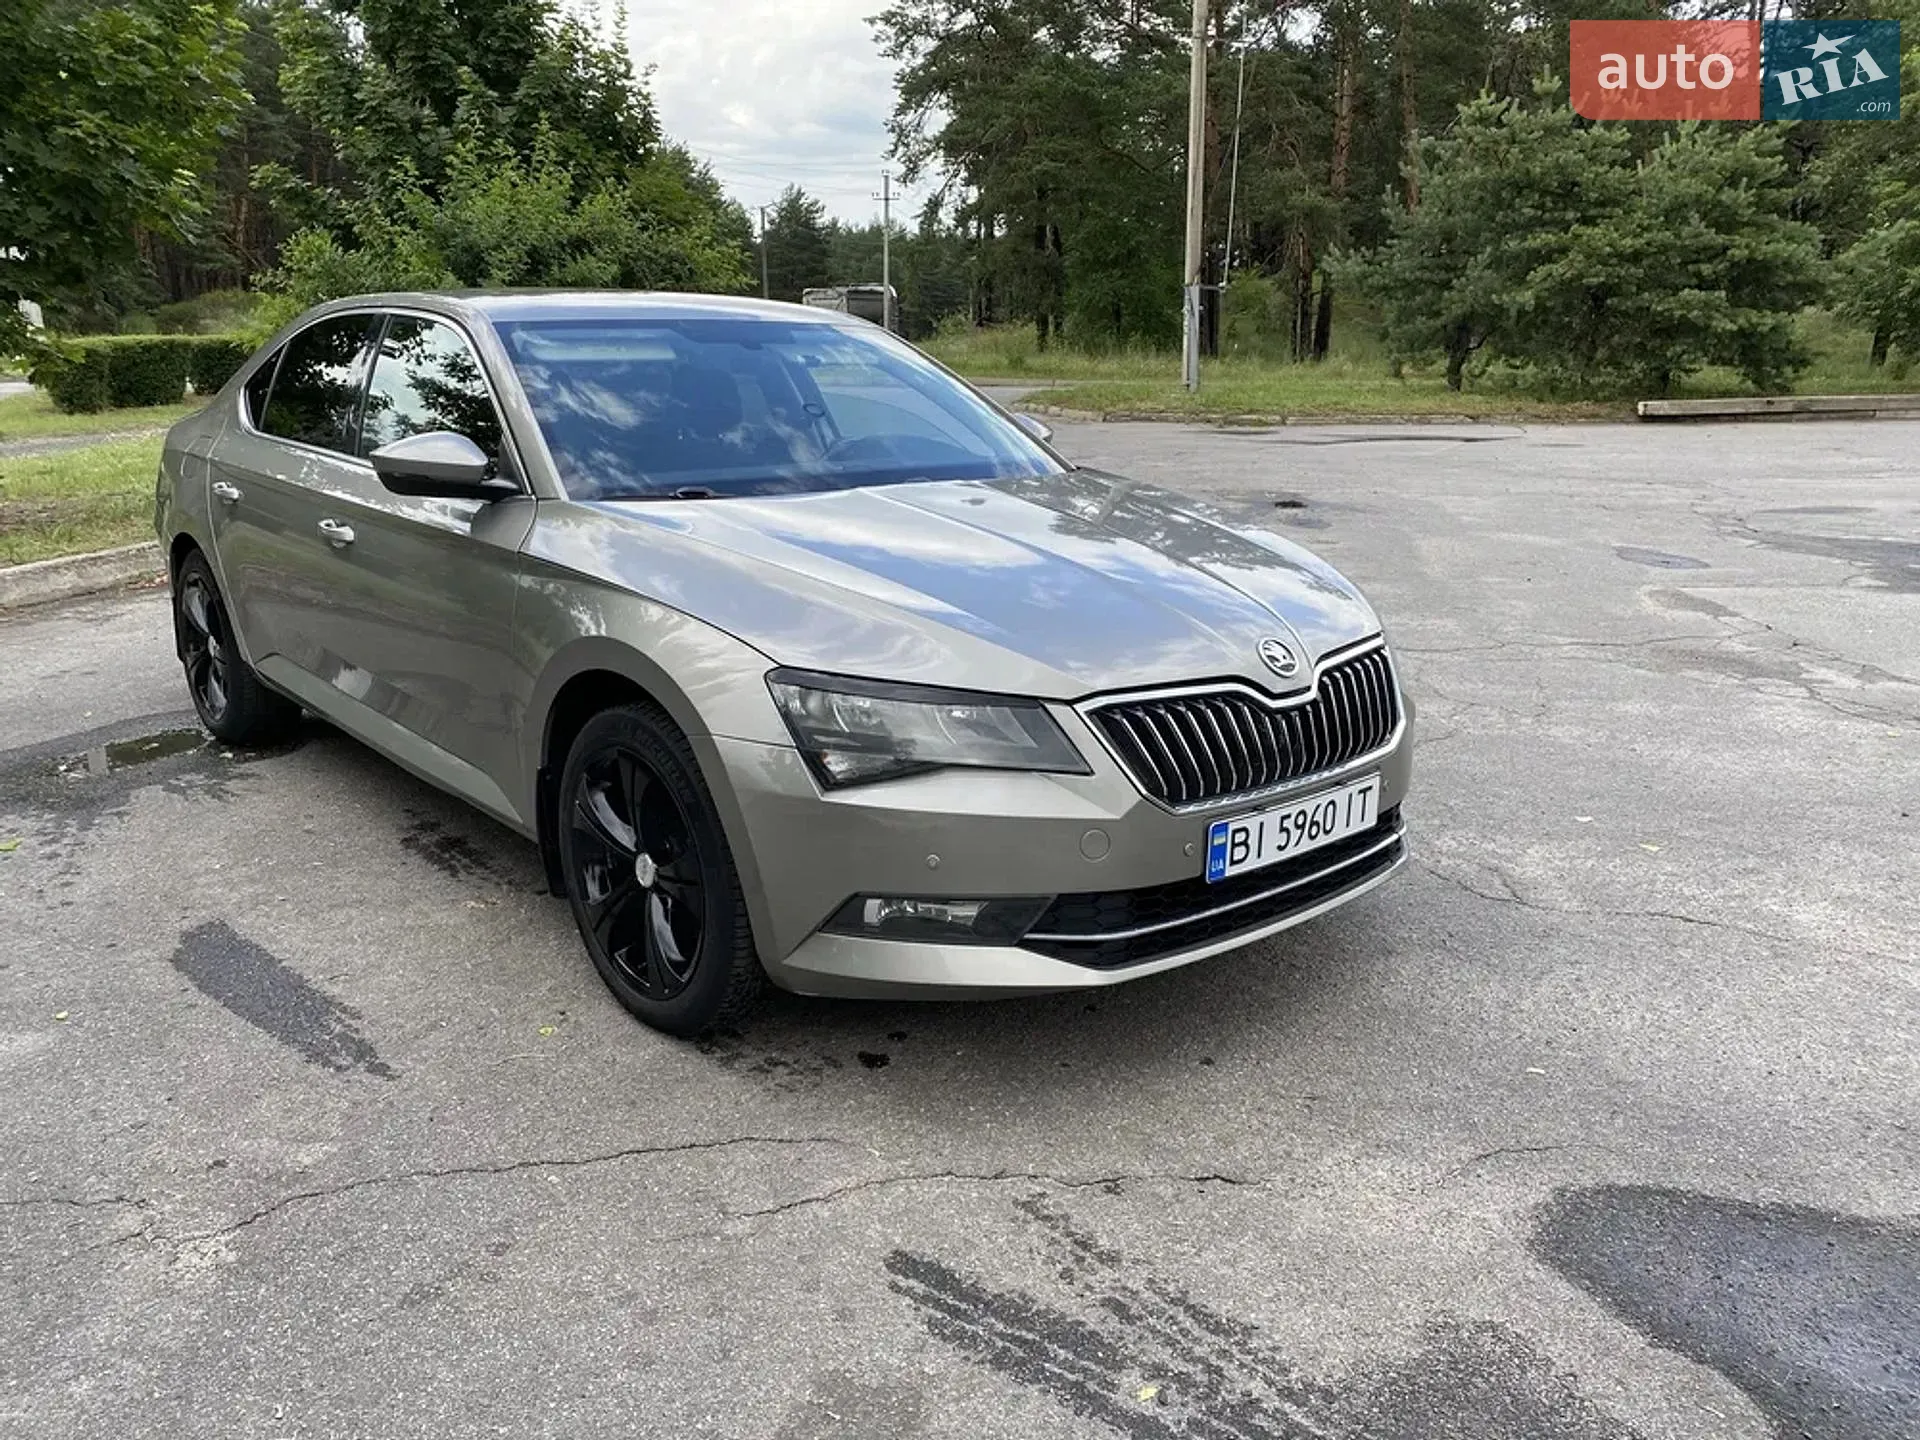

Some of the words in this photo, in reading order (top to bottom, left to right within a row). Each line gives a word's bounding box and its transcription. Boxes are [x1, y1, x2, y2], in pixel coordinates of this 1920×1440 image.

[1229, 821, 1264, 867] BI
[1276, 799, 1337, 851] 5960
[1346, 785, 1373, 828] IT
[1211, 858, 1224, 871] UA
